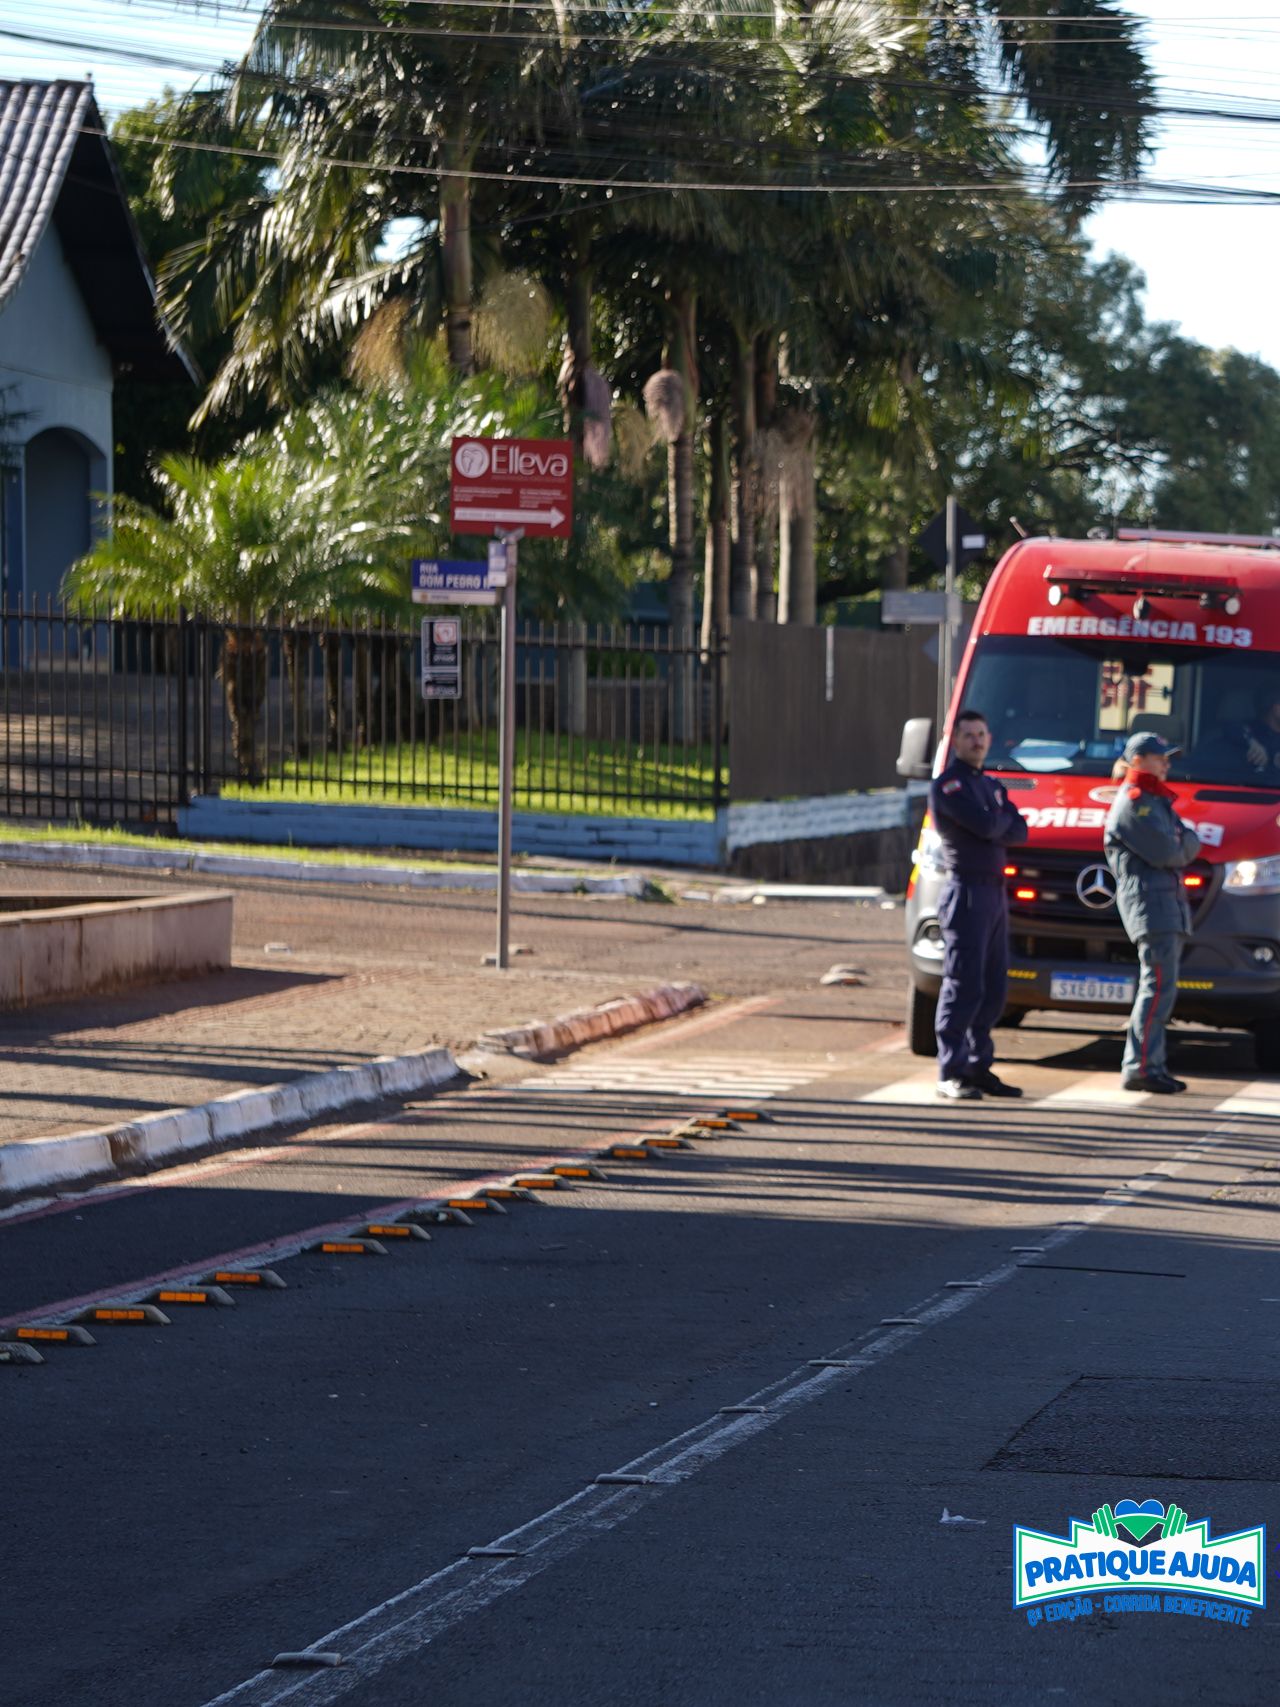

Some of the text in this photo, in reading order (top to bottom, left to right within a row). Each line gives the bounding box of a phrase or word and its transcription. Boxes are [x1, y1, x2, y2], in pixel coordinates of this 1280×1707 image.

[491, 445, 568, 477] Elleva
[419, 563, 439, 575] RUA
[419, 574, 444, 588] DOM
[446, 574, 482, 589] PEDRO
[1026, 614, 1253, 647] EMERGÊNCIA 193
